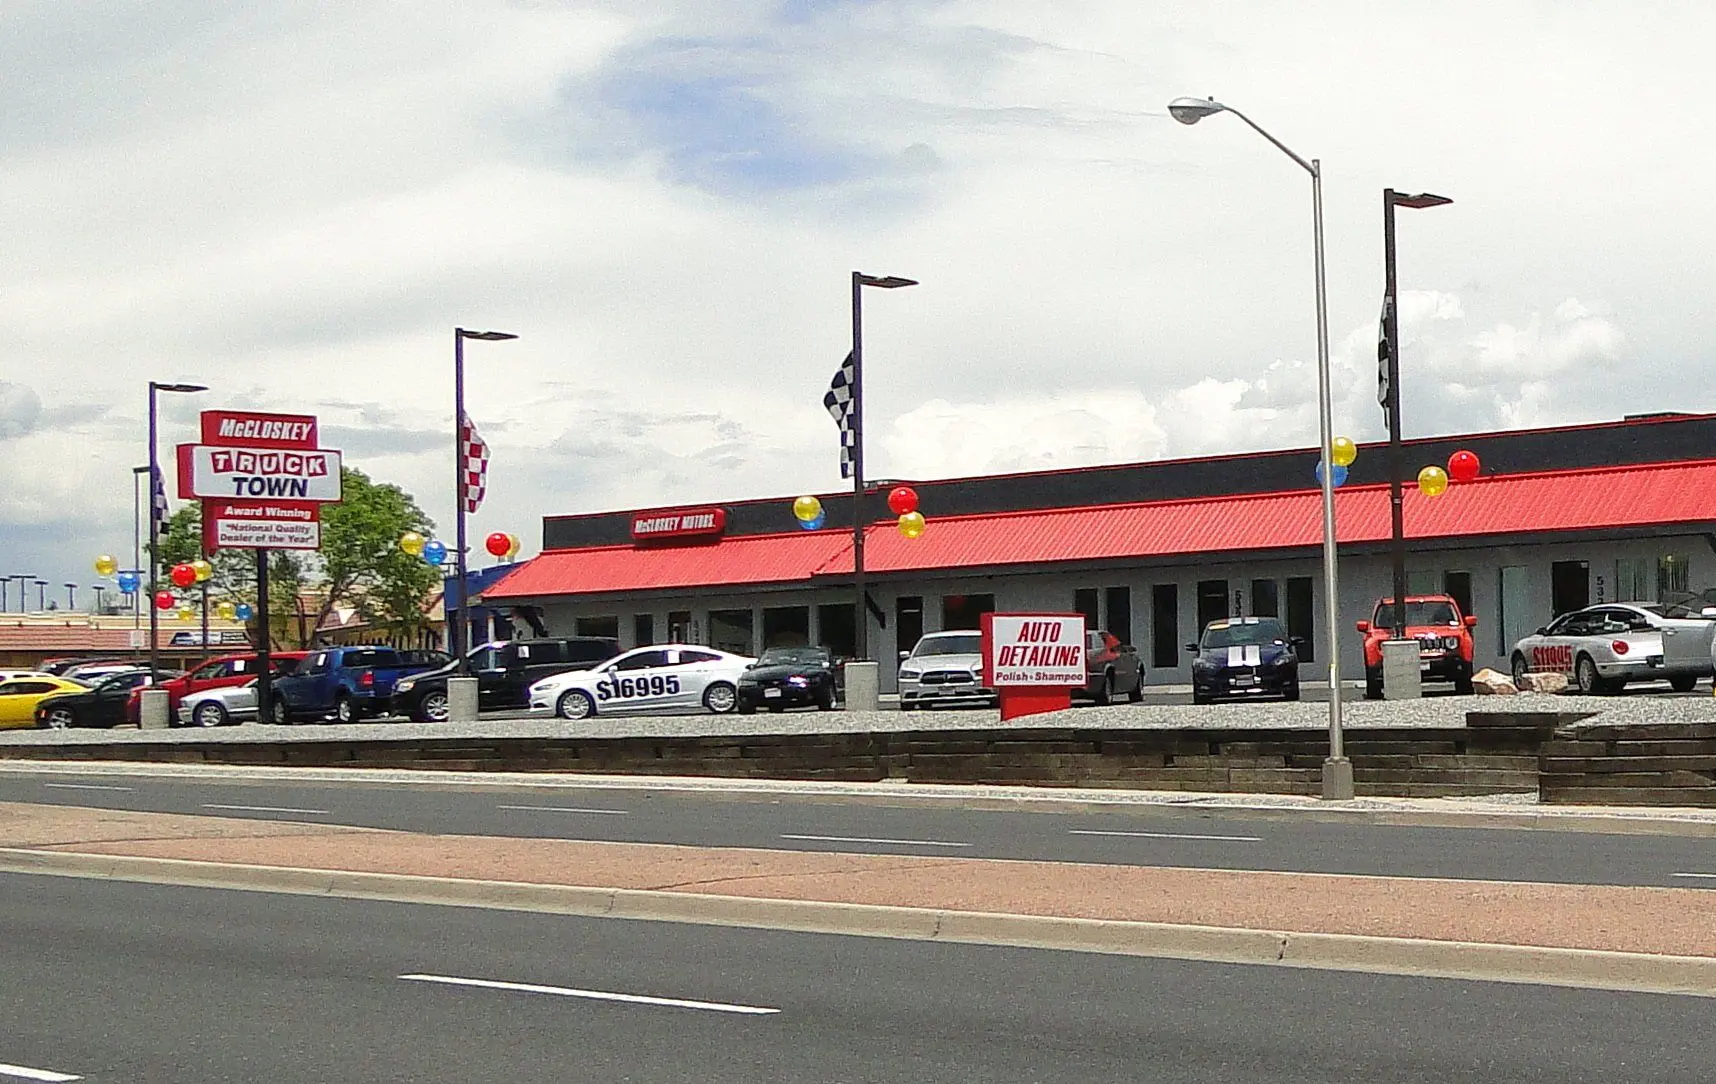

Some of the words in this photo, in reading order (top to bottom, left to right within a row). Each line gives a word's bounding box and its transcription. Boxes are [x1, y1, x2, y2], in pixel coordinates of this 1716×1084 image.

[219, 418, 312, 441] McCLOSKEY
[213, 452, 325, 476] TRUCK
[232, 477, 308, 497] TOWN
[224, 506, 263, 516] Award
[265, 508, 311, 519] Winning
[275, 524, 310, 534] Quality
[634, 517, 680, 533] McCLOSKEY
[220, 533, 252, 542] Dealer
[255, 534, 266, 542] of
[269, 534, 285, 542] the
[1017, 621, 1062, 642] AUTO
[998, 646, 1081, 667] DETAILING
[995, 672, 1030, 681] Polish
[1035, 672, 1083, 682] Shampoo
[596, 675, 680, 701] $16995
